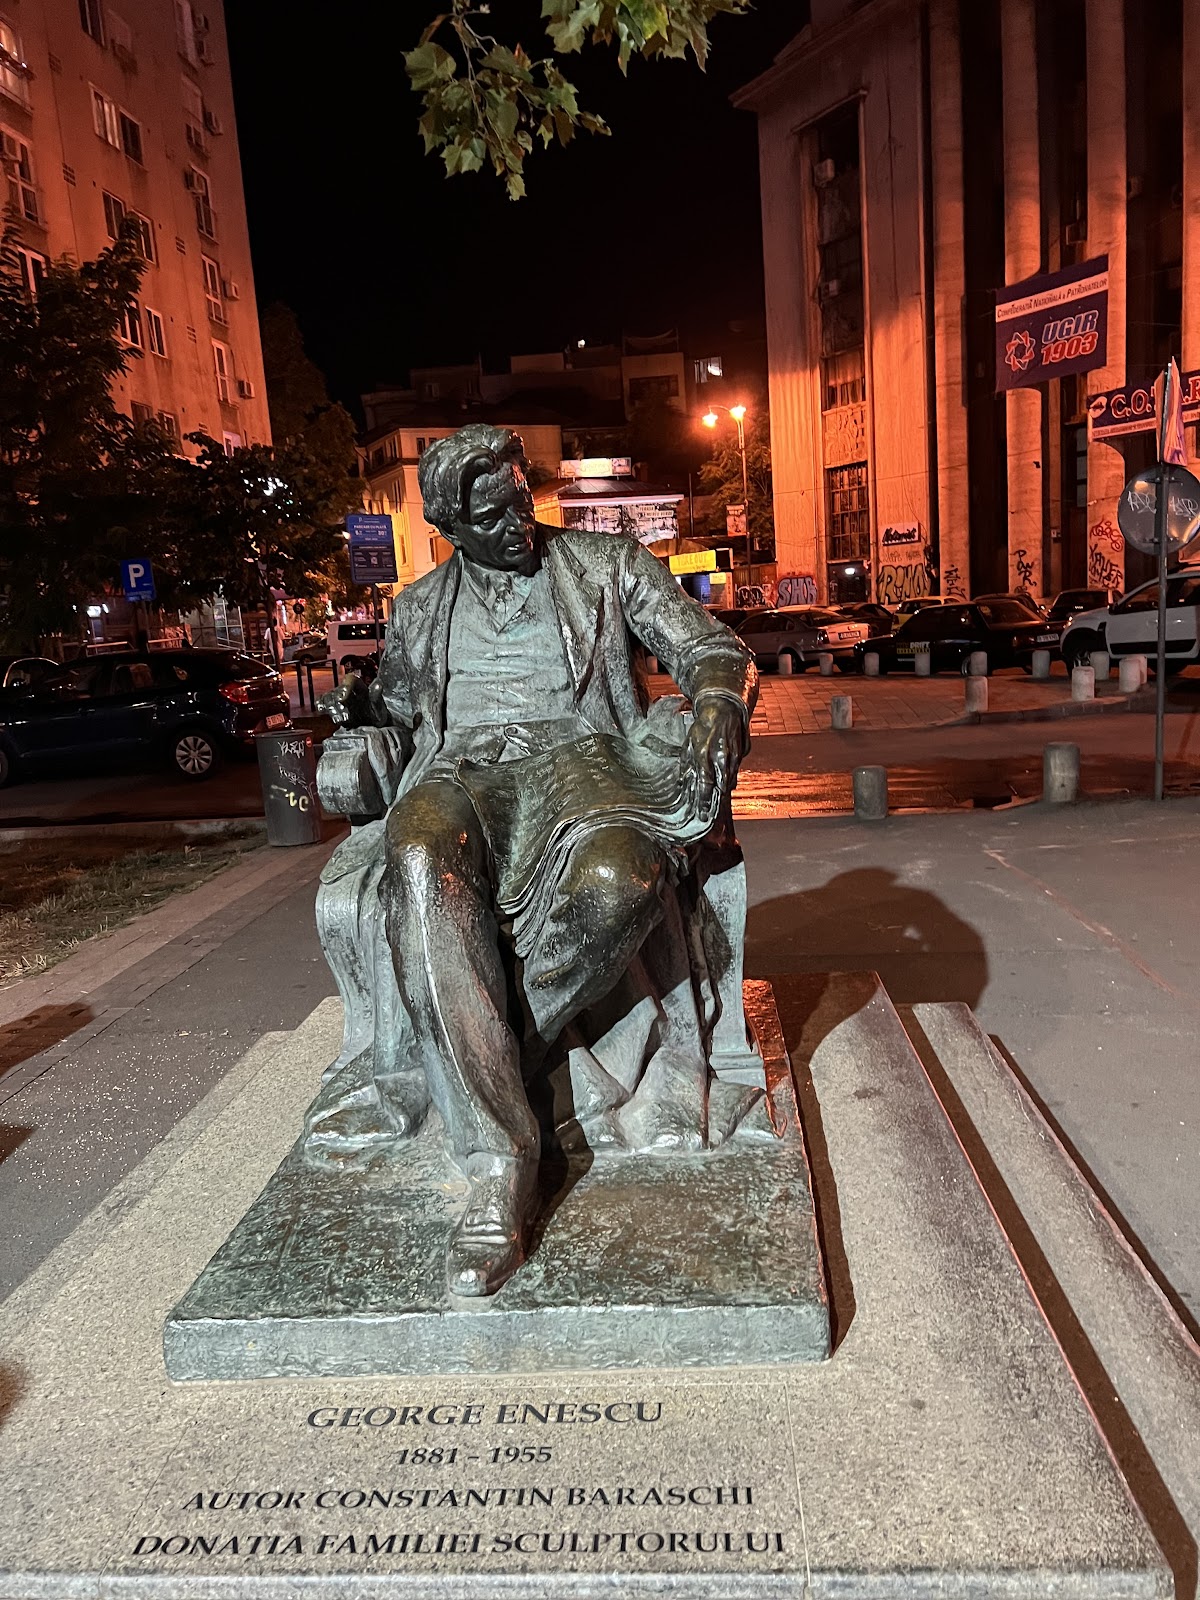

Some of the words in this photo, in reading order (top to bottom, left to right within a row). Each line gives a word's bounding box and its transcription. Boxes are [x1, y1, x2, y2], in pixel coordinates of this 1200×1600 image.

[1066, 278, 1108, 299] PATRONATELOR
[1042, 310, 1099, 344] UGIR
[1041, 332, 1099, 365] 1903
[694, 553, 708, 564] OUT
[128, 563, 145, 588] P
[307, 1404, 485, 1428] GEORGE
[496, 1402, 663, 1425] ENESCU
[398, 1447, 459, 1465] 1881
[489, 1446, 553, 1464] 1955
[182, 1491, 306, 1511] AUTOR
[316, 1487, 555, 1509] CONSTANTIN
[567, 1485, 753, 1507] BARASCHI
[131, 1534, 304, 1556] DONATIA
[316, 1532, 482, 1554] FAMILIEI
[491, 1531, 785, 1554] SCULPTORULUI
